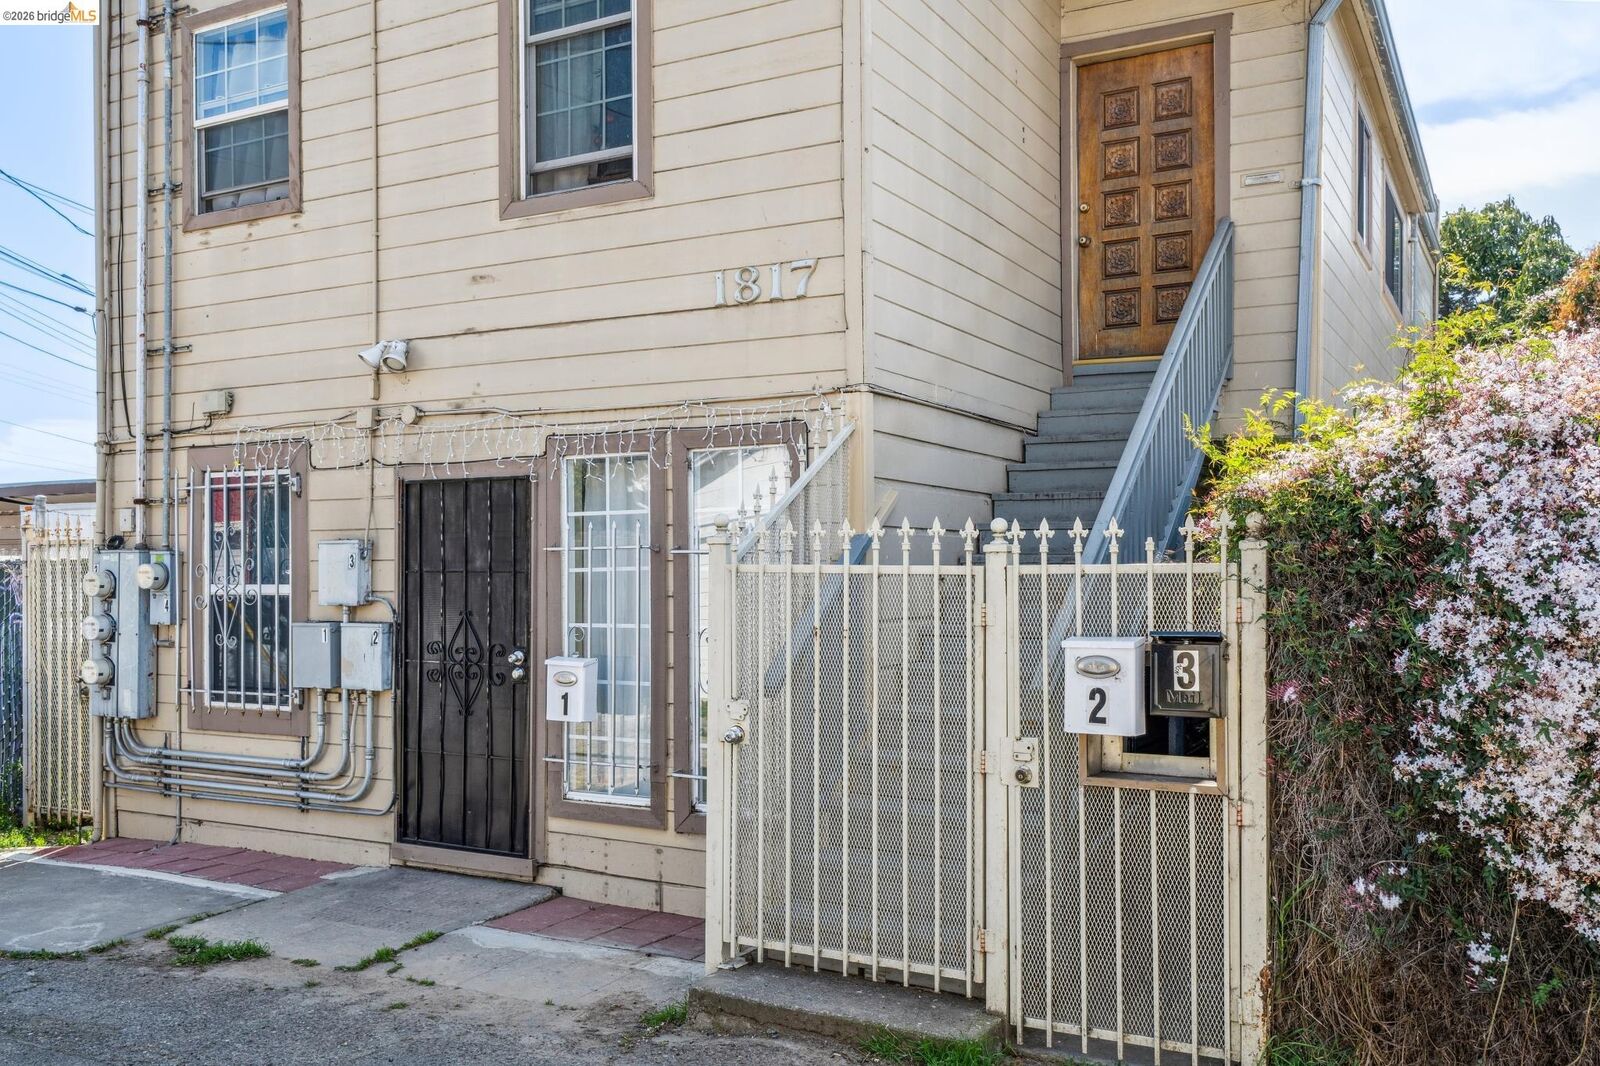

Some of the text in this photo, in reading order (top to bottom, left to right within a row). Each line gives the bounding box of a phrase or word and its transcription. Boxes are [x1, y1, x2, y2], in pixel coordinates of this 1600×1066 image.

[714, 258, 818, 307] 1817
[349, 554, 355, 568] 3
[164, 600, 169, 612] 4
[373, 631, 378, 645] 2
[1177, 651, 1196, 689] 3
[561, 692, 569, 716] 1
[1089, 687, 1107, 725] 2
